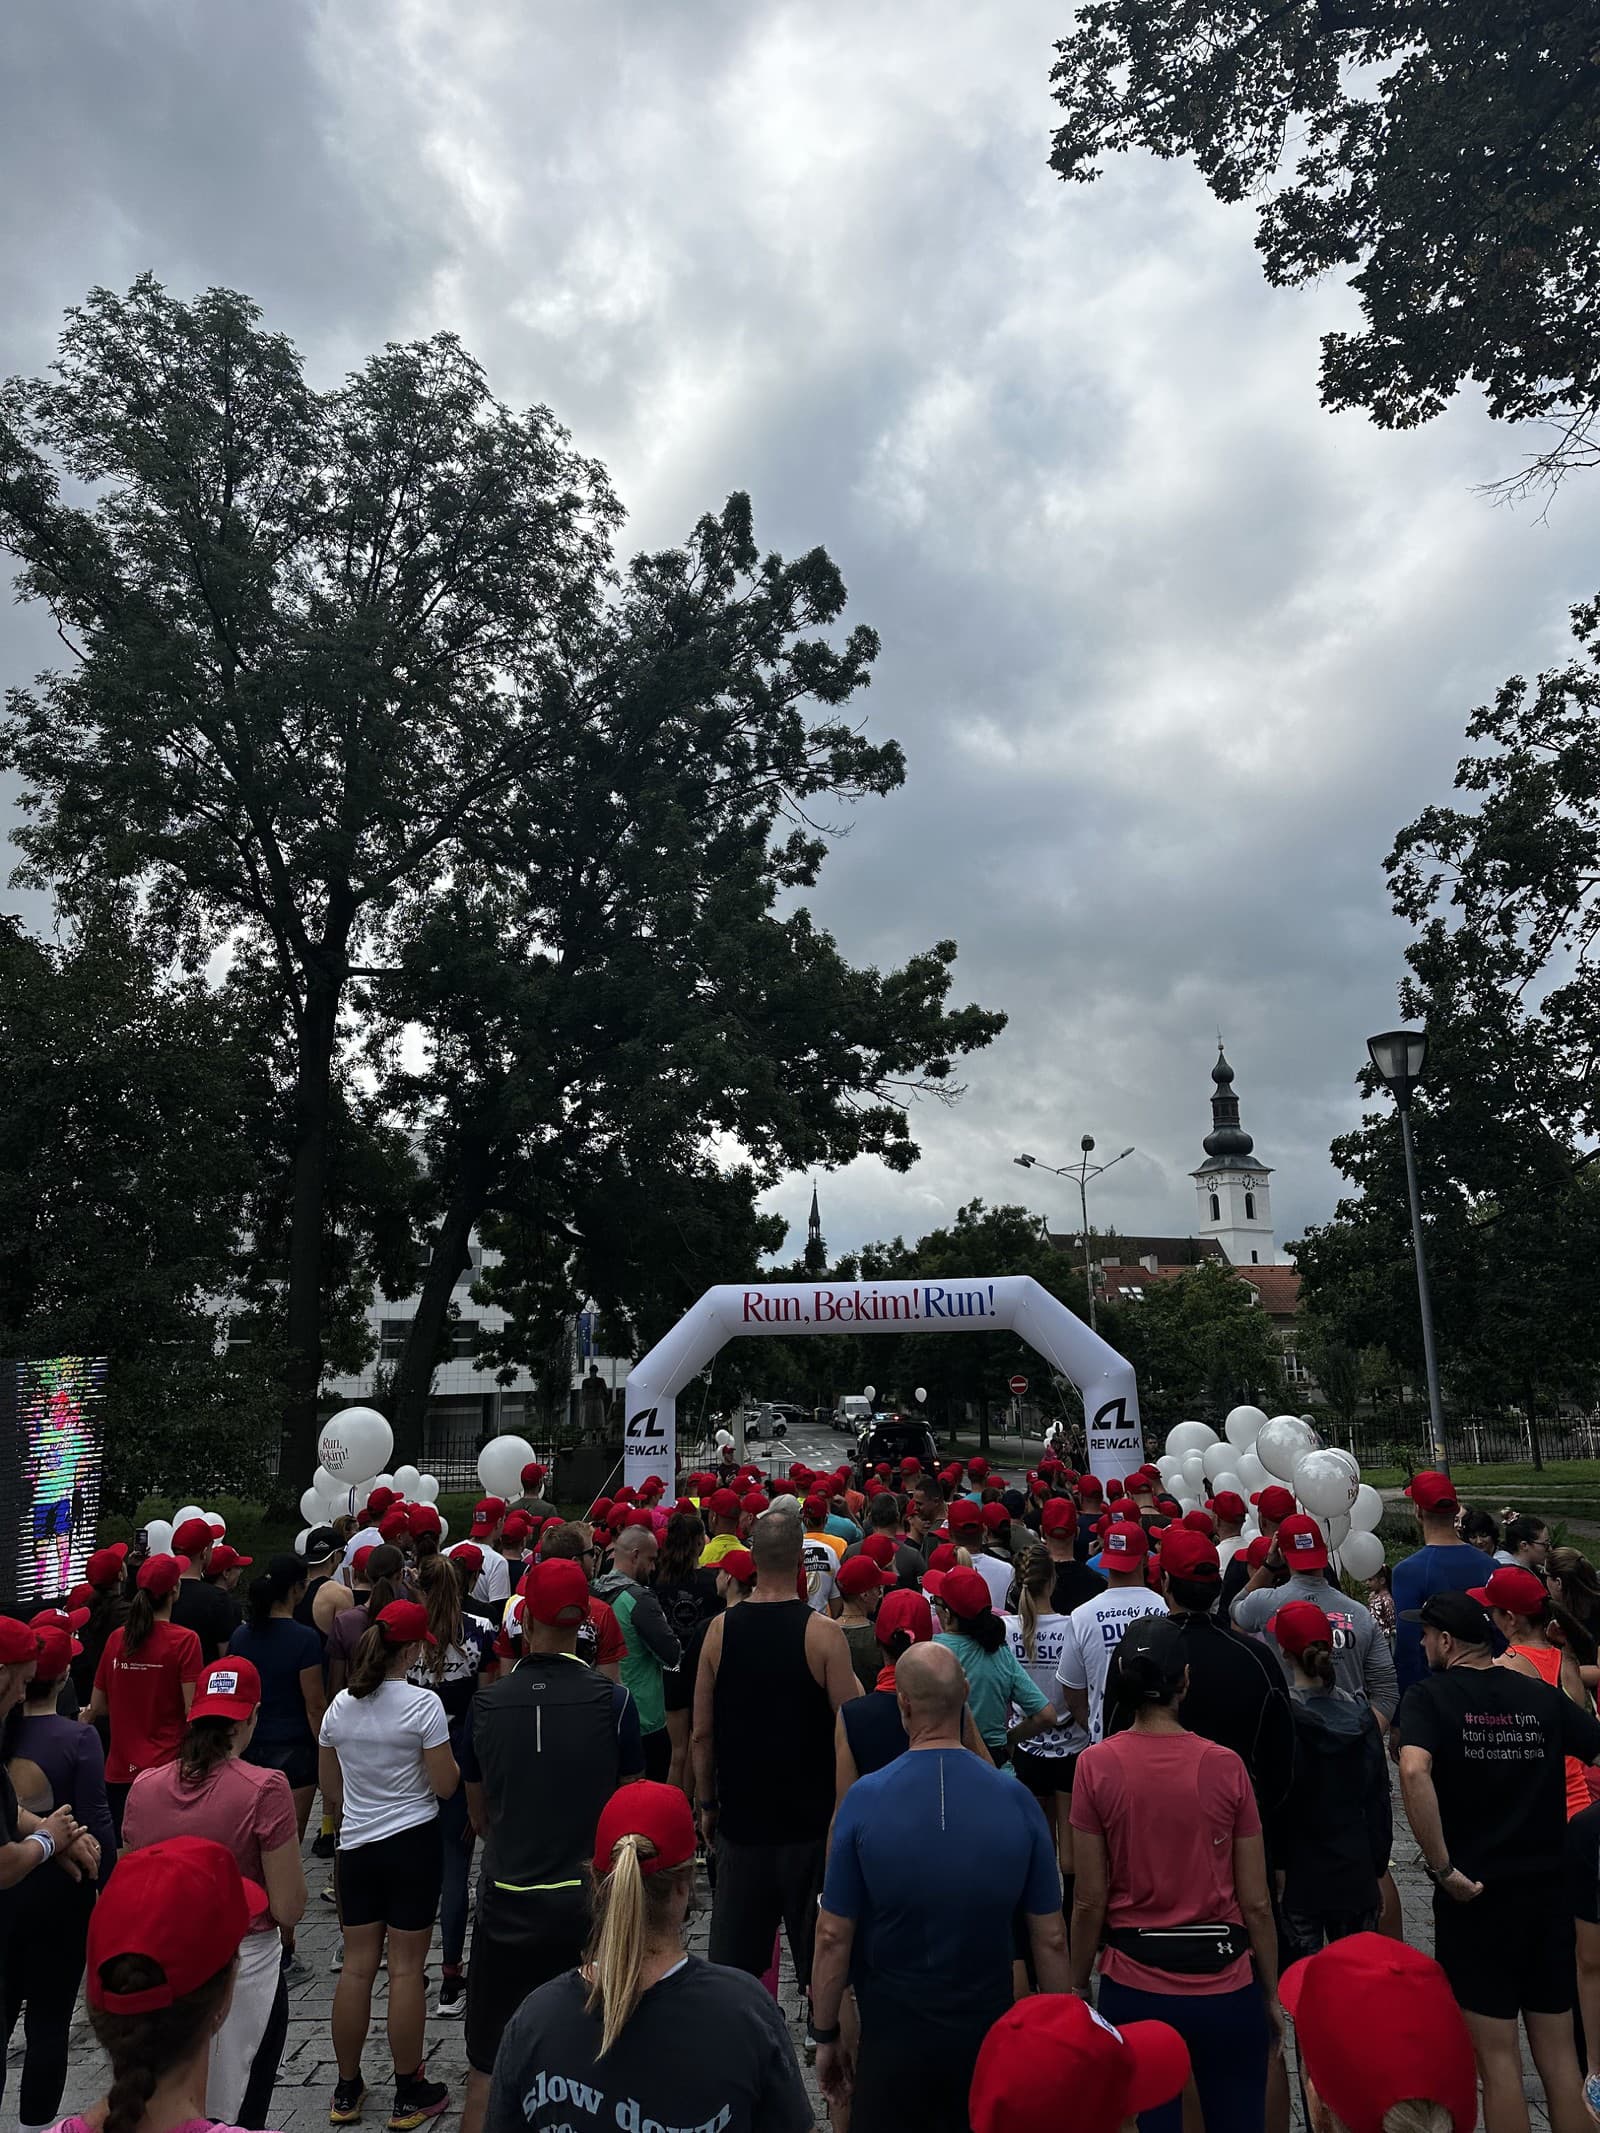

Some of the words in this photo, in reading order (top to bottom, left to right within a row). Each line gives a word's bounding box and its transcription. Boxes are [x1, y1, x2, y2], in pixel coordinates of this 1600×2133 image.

[742, 1292, 810, 1325] Run,
[813, 1288, 920, 1322] Bekim!
[922, 1284, 996, 1318] Run!
[522, 2070, 604, 2122] slow
